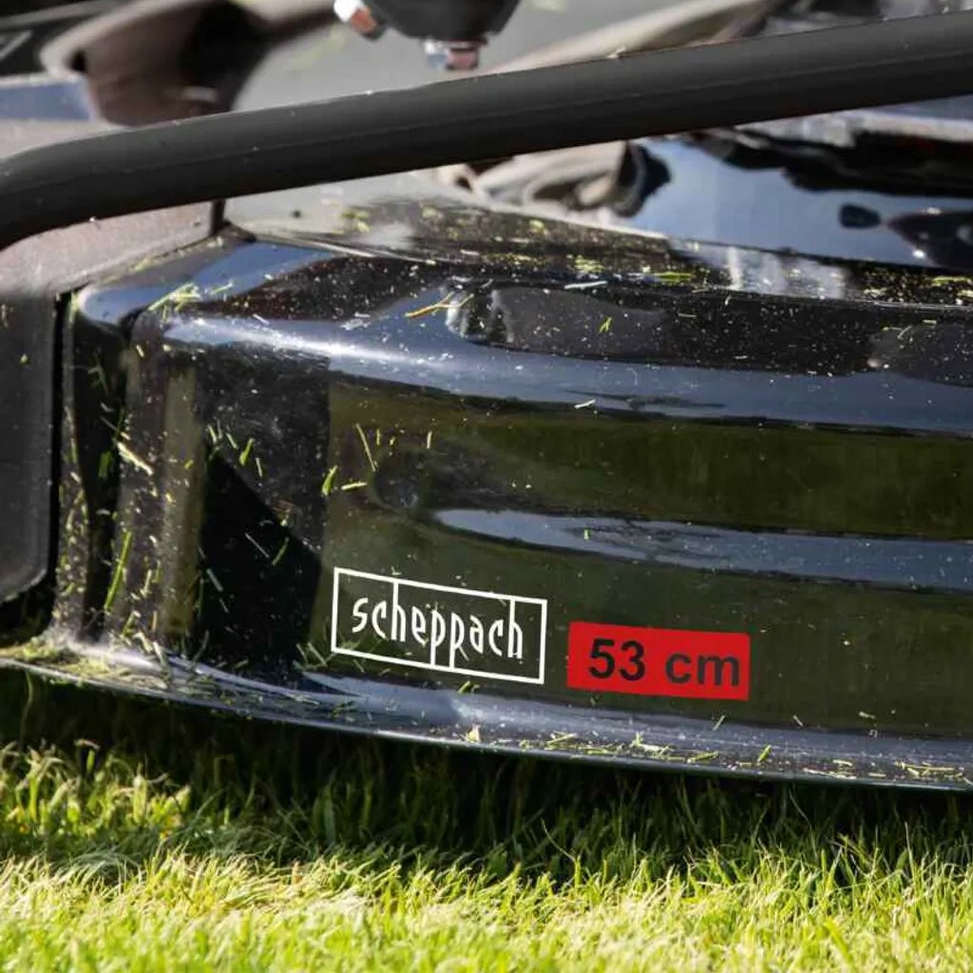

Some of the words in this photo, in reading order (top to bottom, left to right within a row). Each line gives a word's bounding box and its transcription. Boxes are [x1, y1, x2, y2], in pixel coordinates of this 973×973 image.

[351, 583, 524, 669] scheppach
[588, 638, 646, 681] 53
[665, 652, 741, 688] cm
